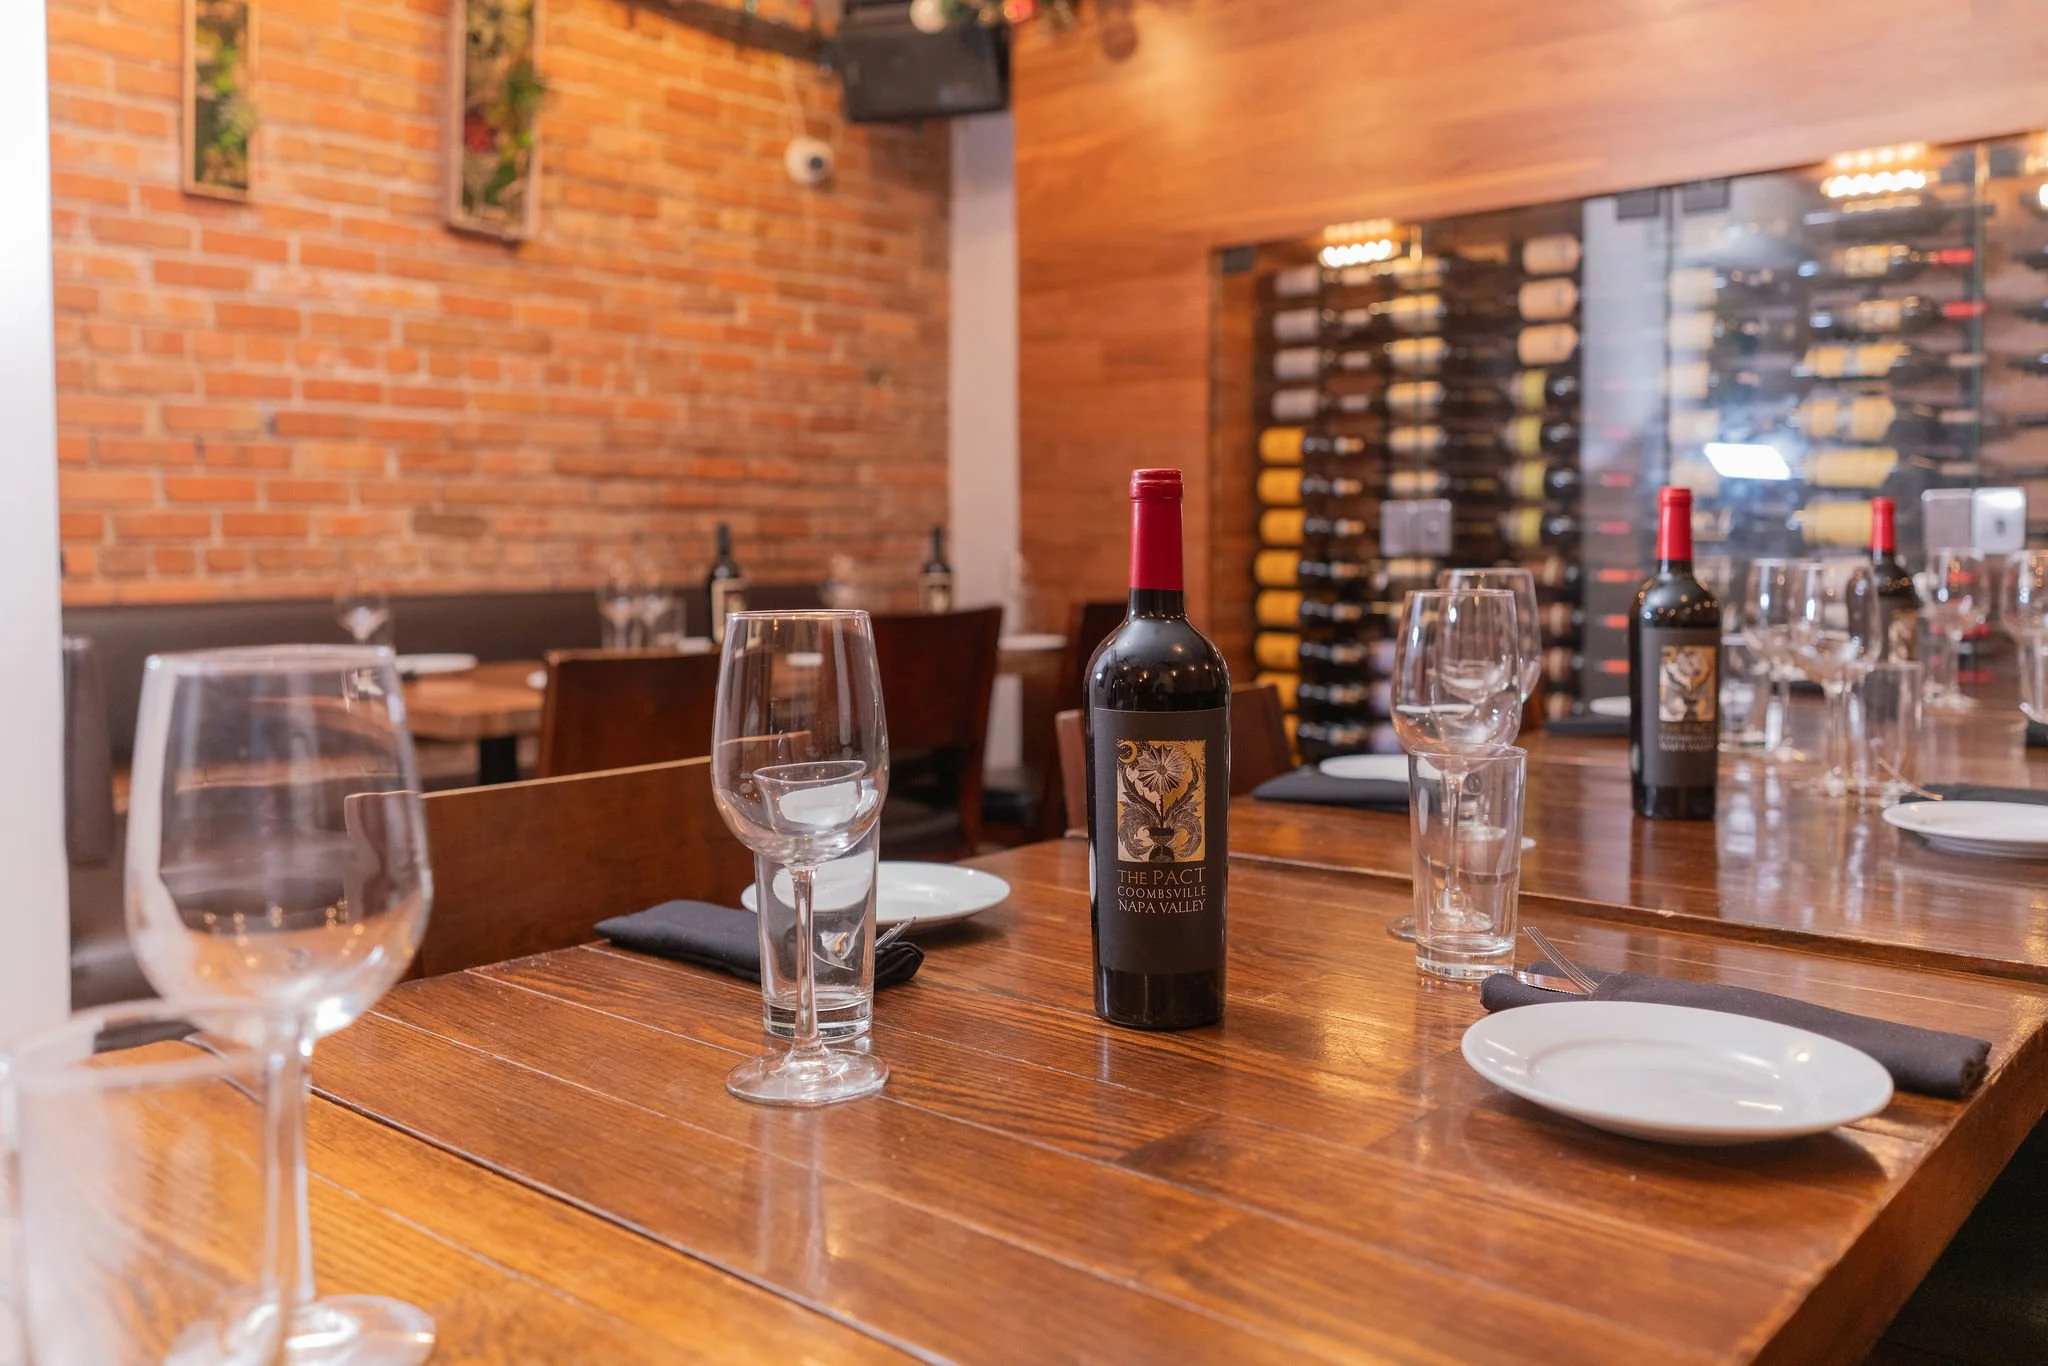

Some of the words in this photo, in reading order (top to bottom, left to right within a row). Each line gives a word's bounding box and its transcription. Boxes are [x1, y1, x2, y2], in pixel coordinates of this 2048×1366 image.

[1117, 869, 1147, 885] THE
[1153, 867, 1206, 885] PACT
[1117, 886, 1206, 899] COOMBSVILLE
[1118, 899, 1156, 913] NAPA
[1160, 899, 1206, 913] VALLEY
